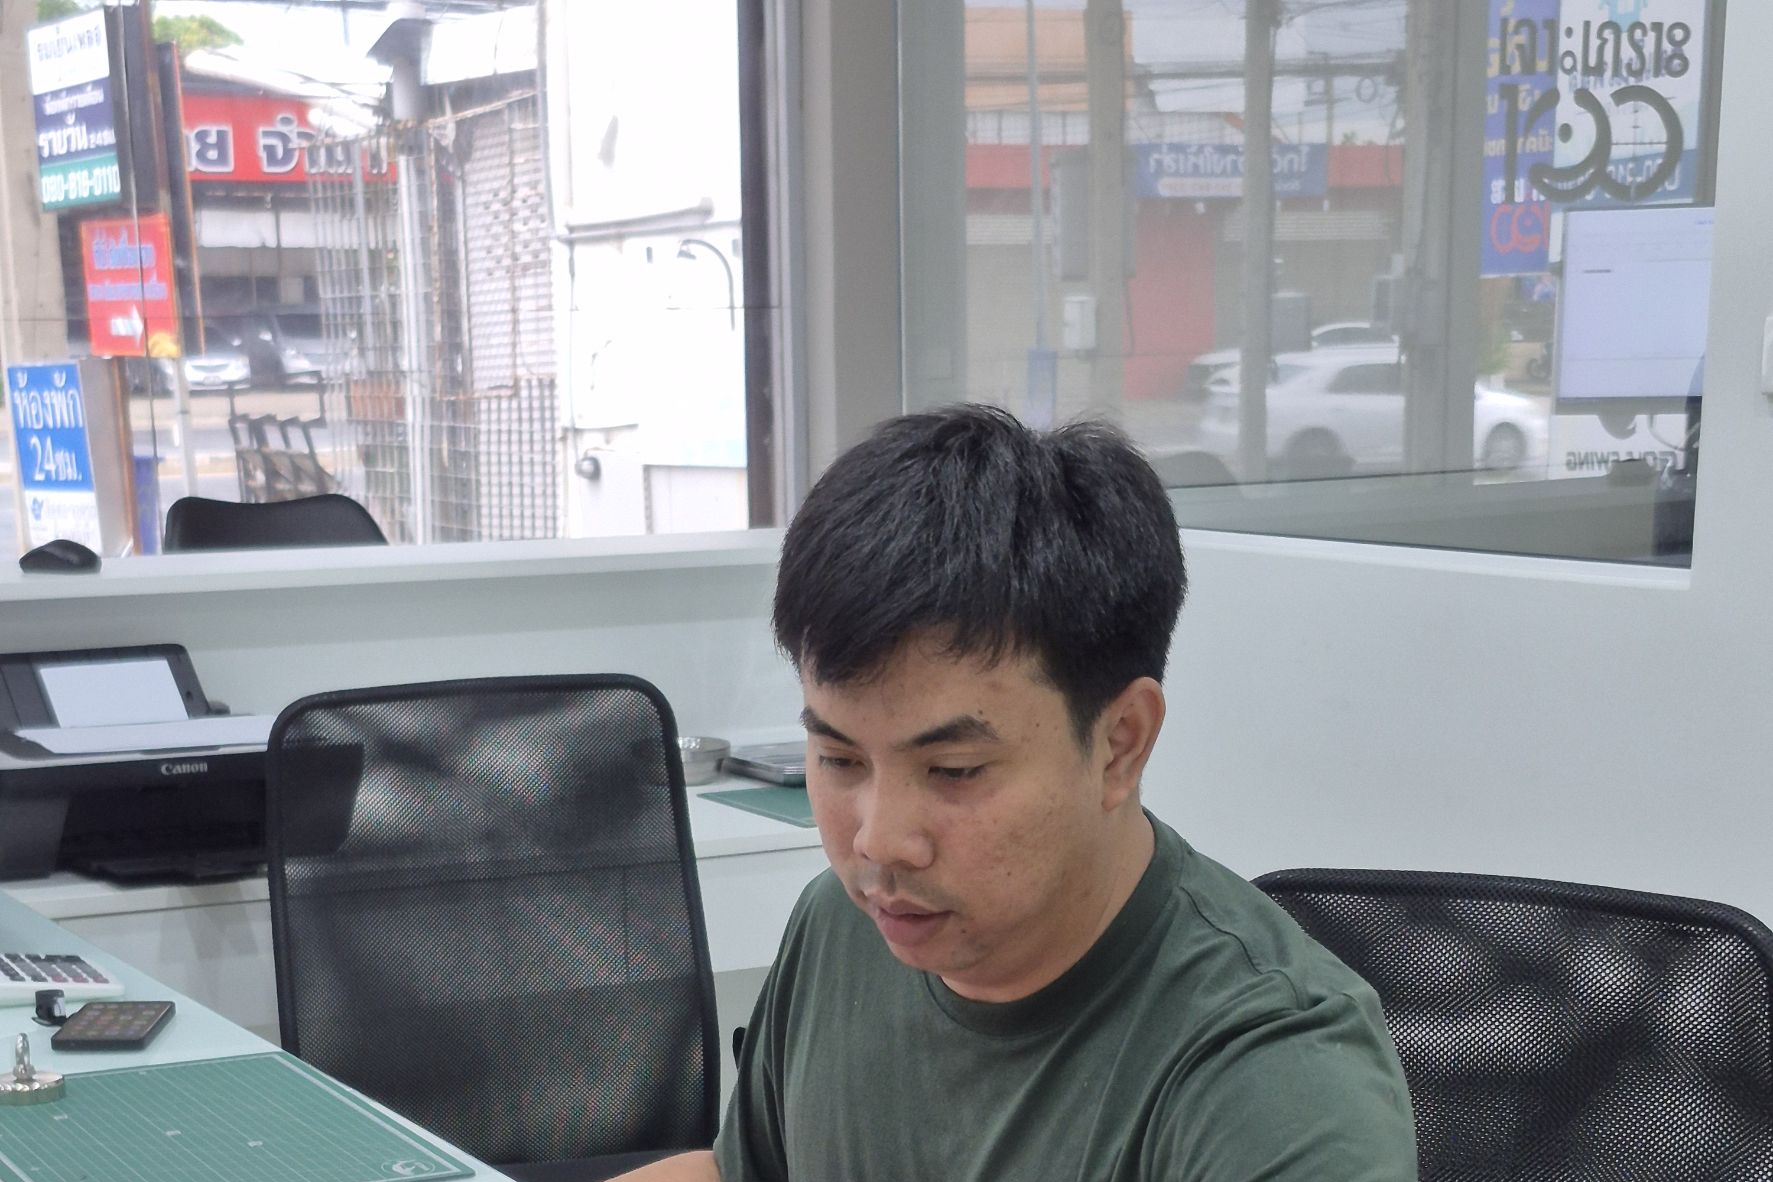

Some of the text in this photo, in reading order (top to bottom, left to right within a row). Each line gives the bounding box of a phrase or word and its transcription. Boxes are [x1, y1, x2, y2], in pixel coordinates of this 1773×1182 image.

[13, 370, 84, 430] ห้องพัก
[160, 762, 208, 775] Canon
